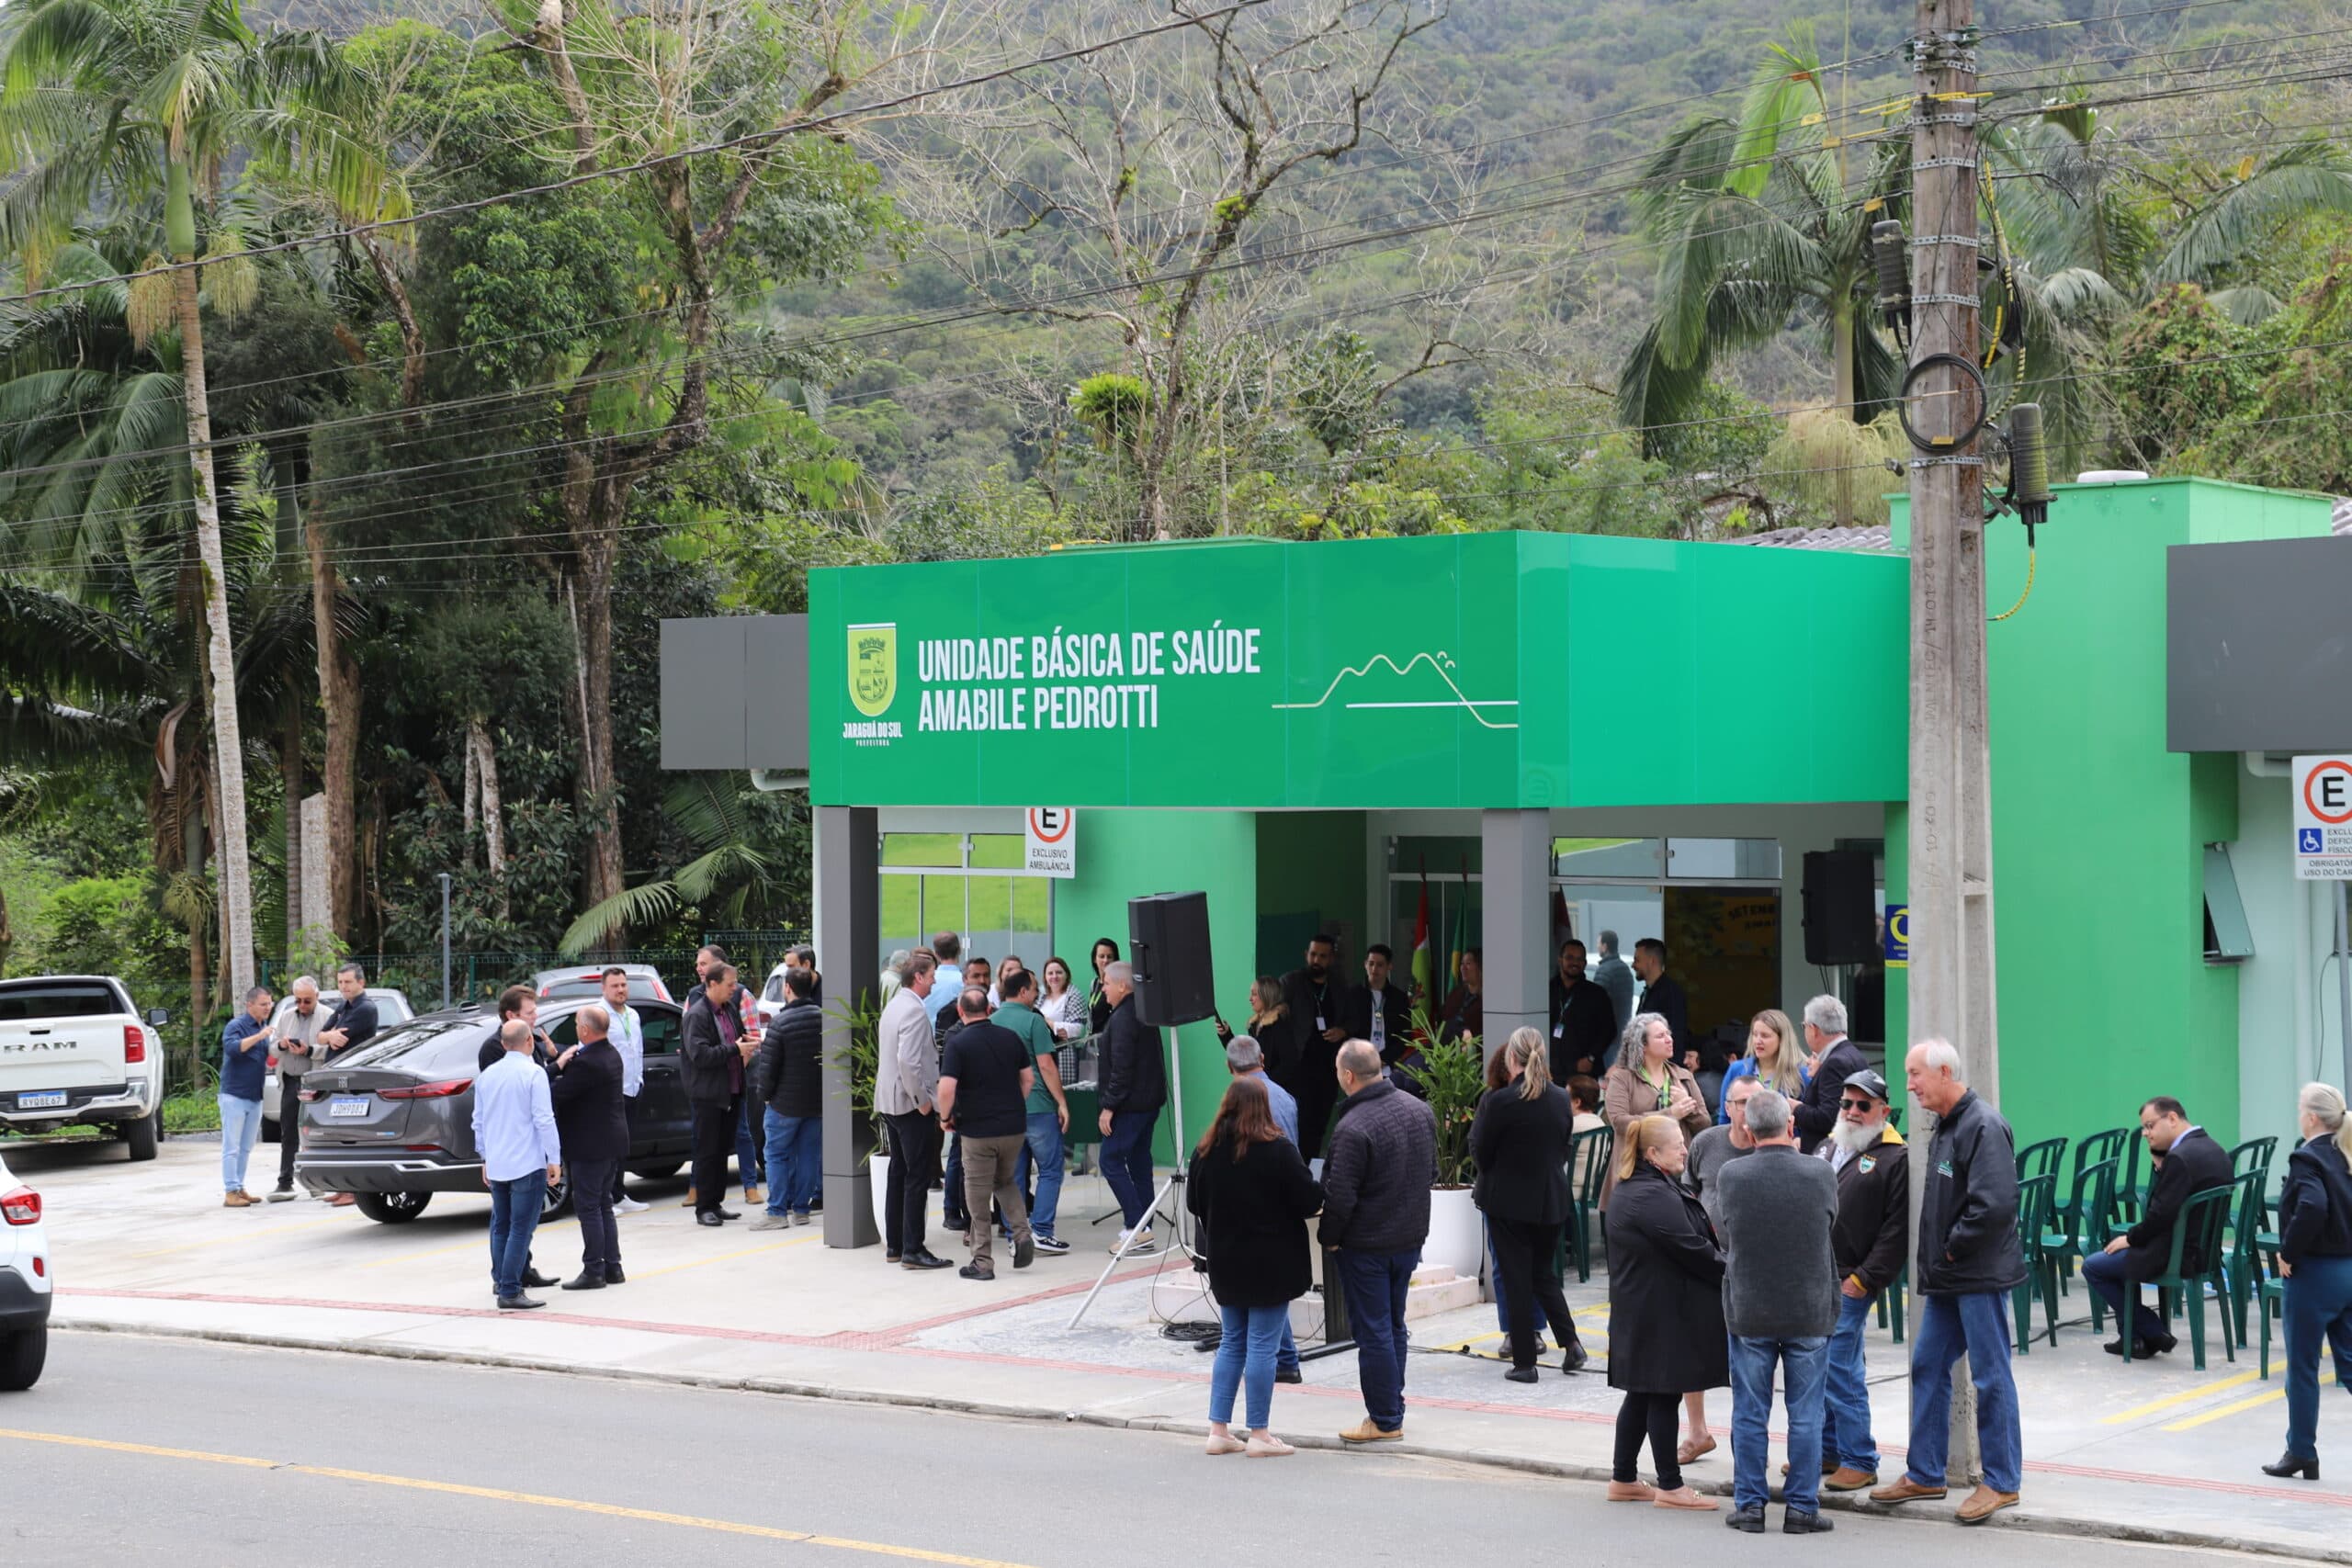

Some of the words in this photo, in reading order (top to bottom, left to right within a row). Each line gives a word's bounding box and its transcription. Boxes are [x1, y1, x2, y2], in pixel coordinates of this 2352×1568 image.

[919, 637, 1024, 682] UNIDADE
[1032, 626, 1124, 679] BÁSICA
[1131, 632, 1165, 676] DE
[1172, 619, 1261, 675] SAÚDE
[918, 687, 1026, 732] AMABILE
[1034, 684, 1158, 729] PEDROTTI
[842, 720, 876, 739] JARAGUÁ
[876, 722, 888, 738] DO
[888, 721, 903, 738] SUL
[2322, 776, 2346, 807] E
[1042, 808, 1057, 829] E
[1032, 848, 1068, 859] EXCLUSIVO
[1029, 860, 1071, 872] AMBULÂNCIA
[2303, 868, 2321, 876] USO
[2323, 868, 2335, 876] DO
[3, 1041, 77, 1054] RAM
